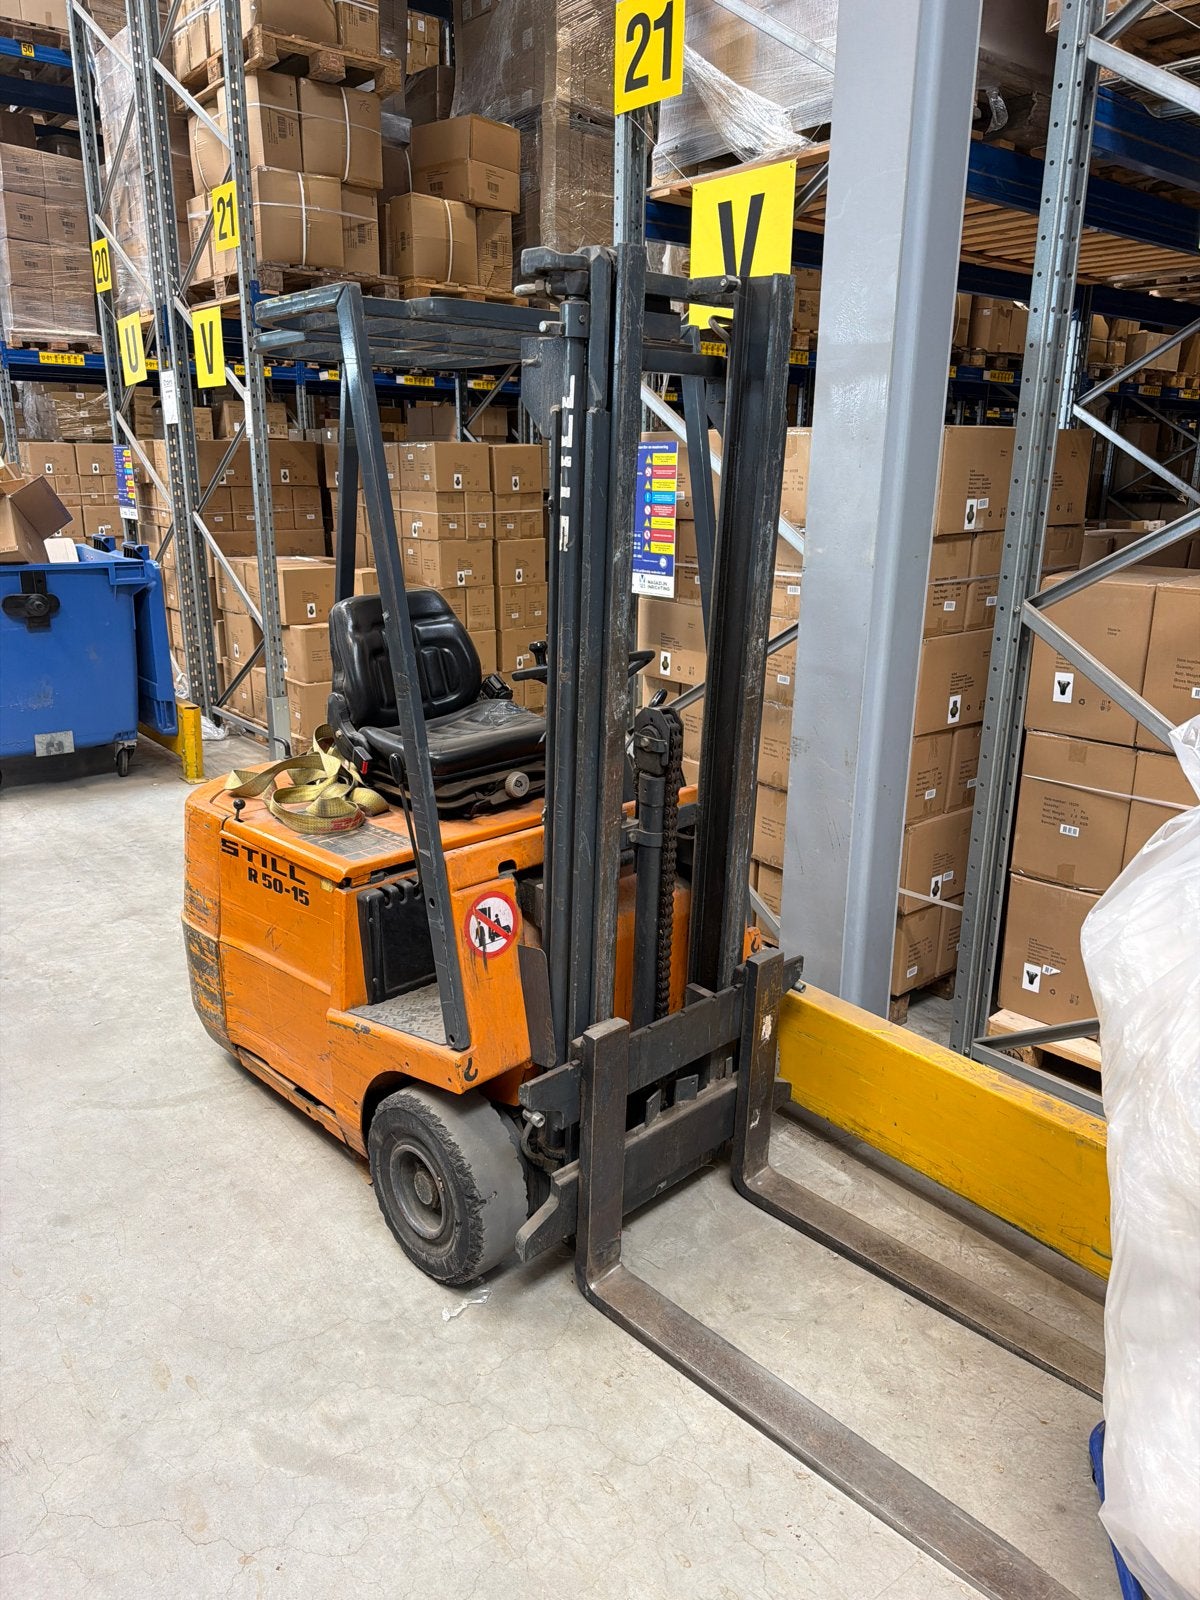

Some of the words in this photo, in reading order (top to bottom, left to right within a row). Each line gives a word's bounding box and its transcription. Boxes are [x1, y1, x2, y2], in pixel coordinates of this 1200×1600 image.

[22, 44, 33, 54] 50
[624, 1, 674, 93] 21
[216, 192, 236, 241] 21
[718, 192, 765, 277] V
[94, 246, 109, 285] 20
[125, 322, 140, 373] U
[199, 321, 215, 375] V
[221, 838, 306, 885] STILL
[247, 867, 259, 885] R
[261, 872, 310, 907] 50-15
